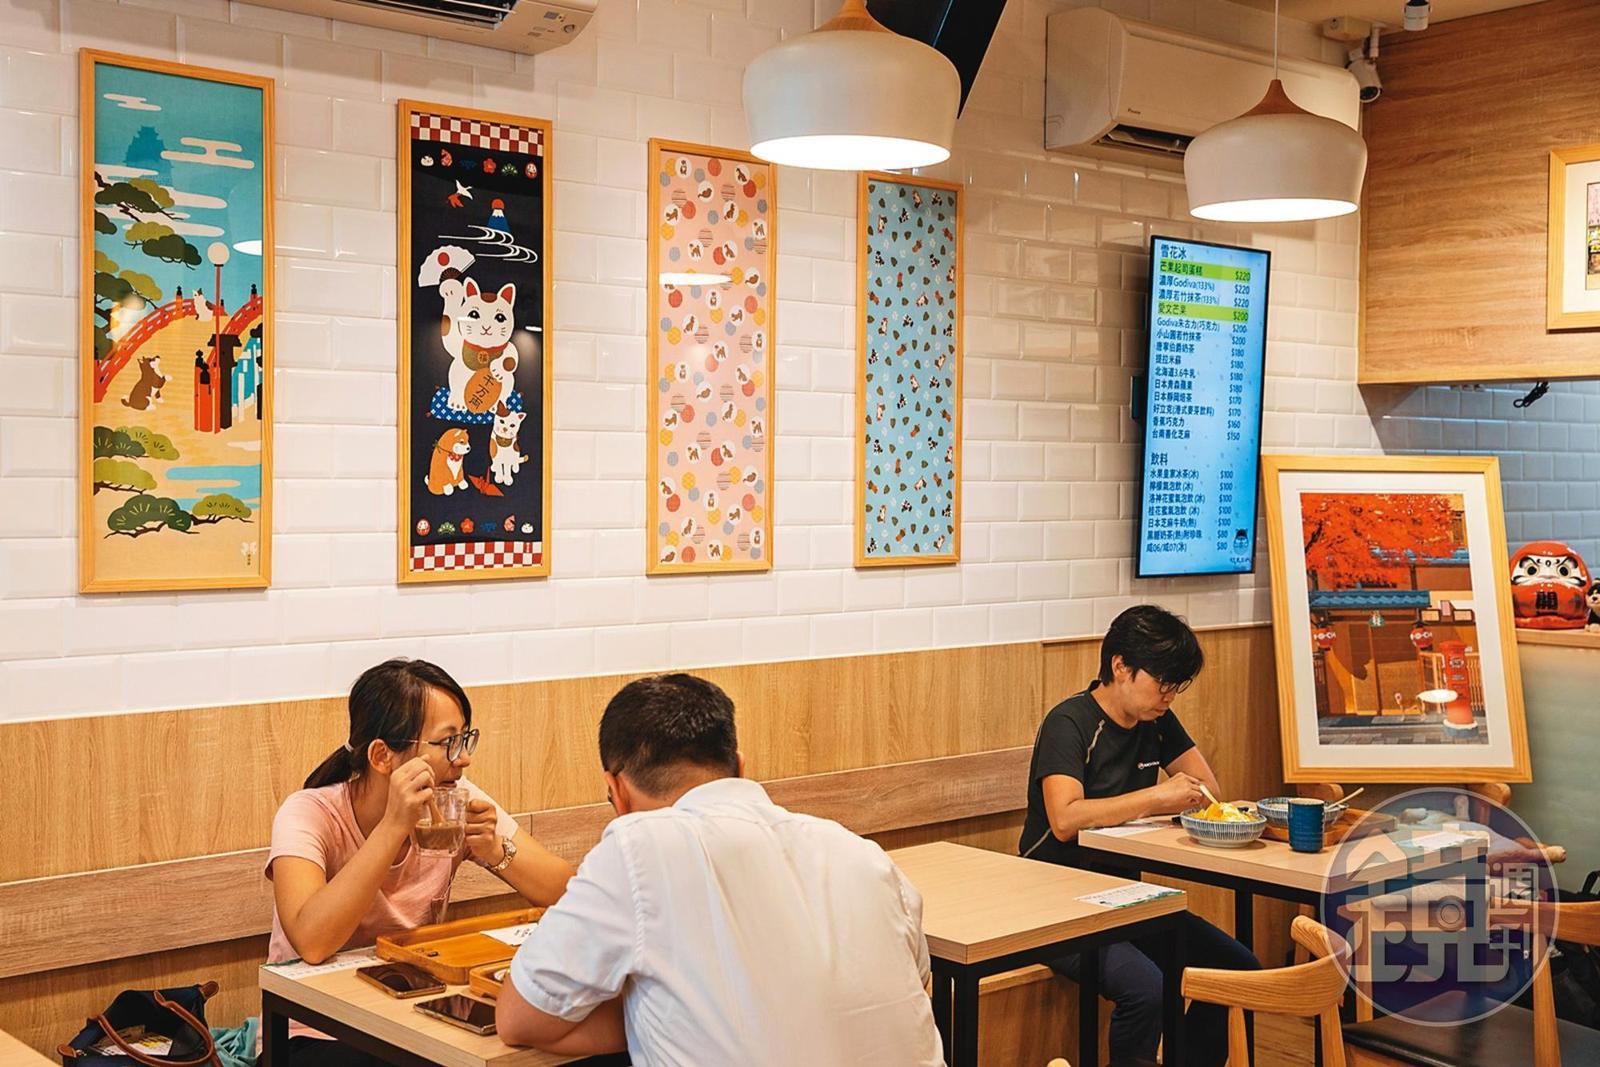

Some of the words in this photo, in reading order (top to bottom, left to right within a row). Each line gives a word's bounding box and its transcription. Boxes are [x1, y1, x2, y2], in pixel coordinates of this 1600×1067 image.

[1161, 244, 1187, 260] 雪花冰
[1235, 270, 1251, 281] $220
[1234, 284, 1250, 295] $220
[1234, 297, 1250, 308] $220
[1233, 310, 1249, 321] $200
[1232, 324, 1248, 334] $200
[1232, 336, 1246, 345] $200
[1231, 348, 1245, 357] $180
[1230, 360, 1244, 369] $180
[1230, 372, 1243, 381] $180
[1229, 396, 1242, 405] $170
[1228, 408, 1241, 417] $170
[1227, 420, 1240, 429] $160
[1227, 432, 1240, 441] $150
[1151, 452, 1168, 466] 飲料
[1220, 470, 1234, 479] $100
[1220, 482, 1233, 491] $100
[1219, 494, 1233, 503] $100
[1218, 506, 1232, 515] $100
[1218, 518, 1231, 527] $100
